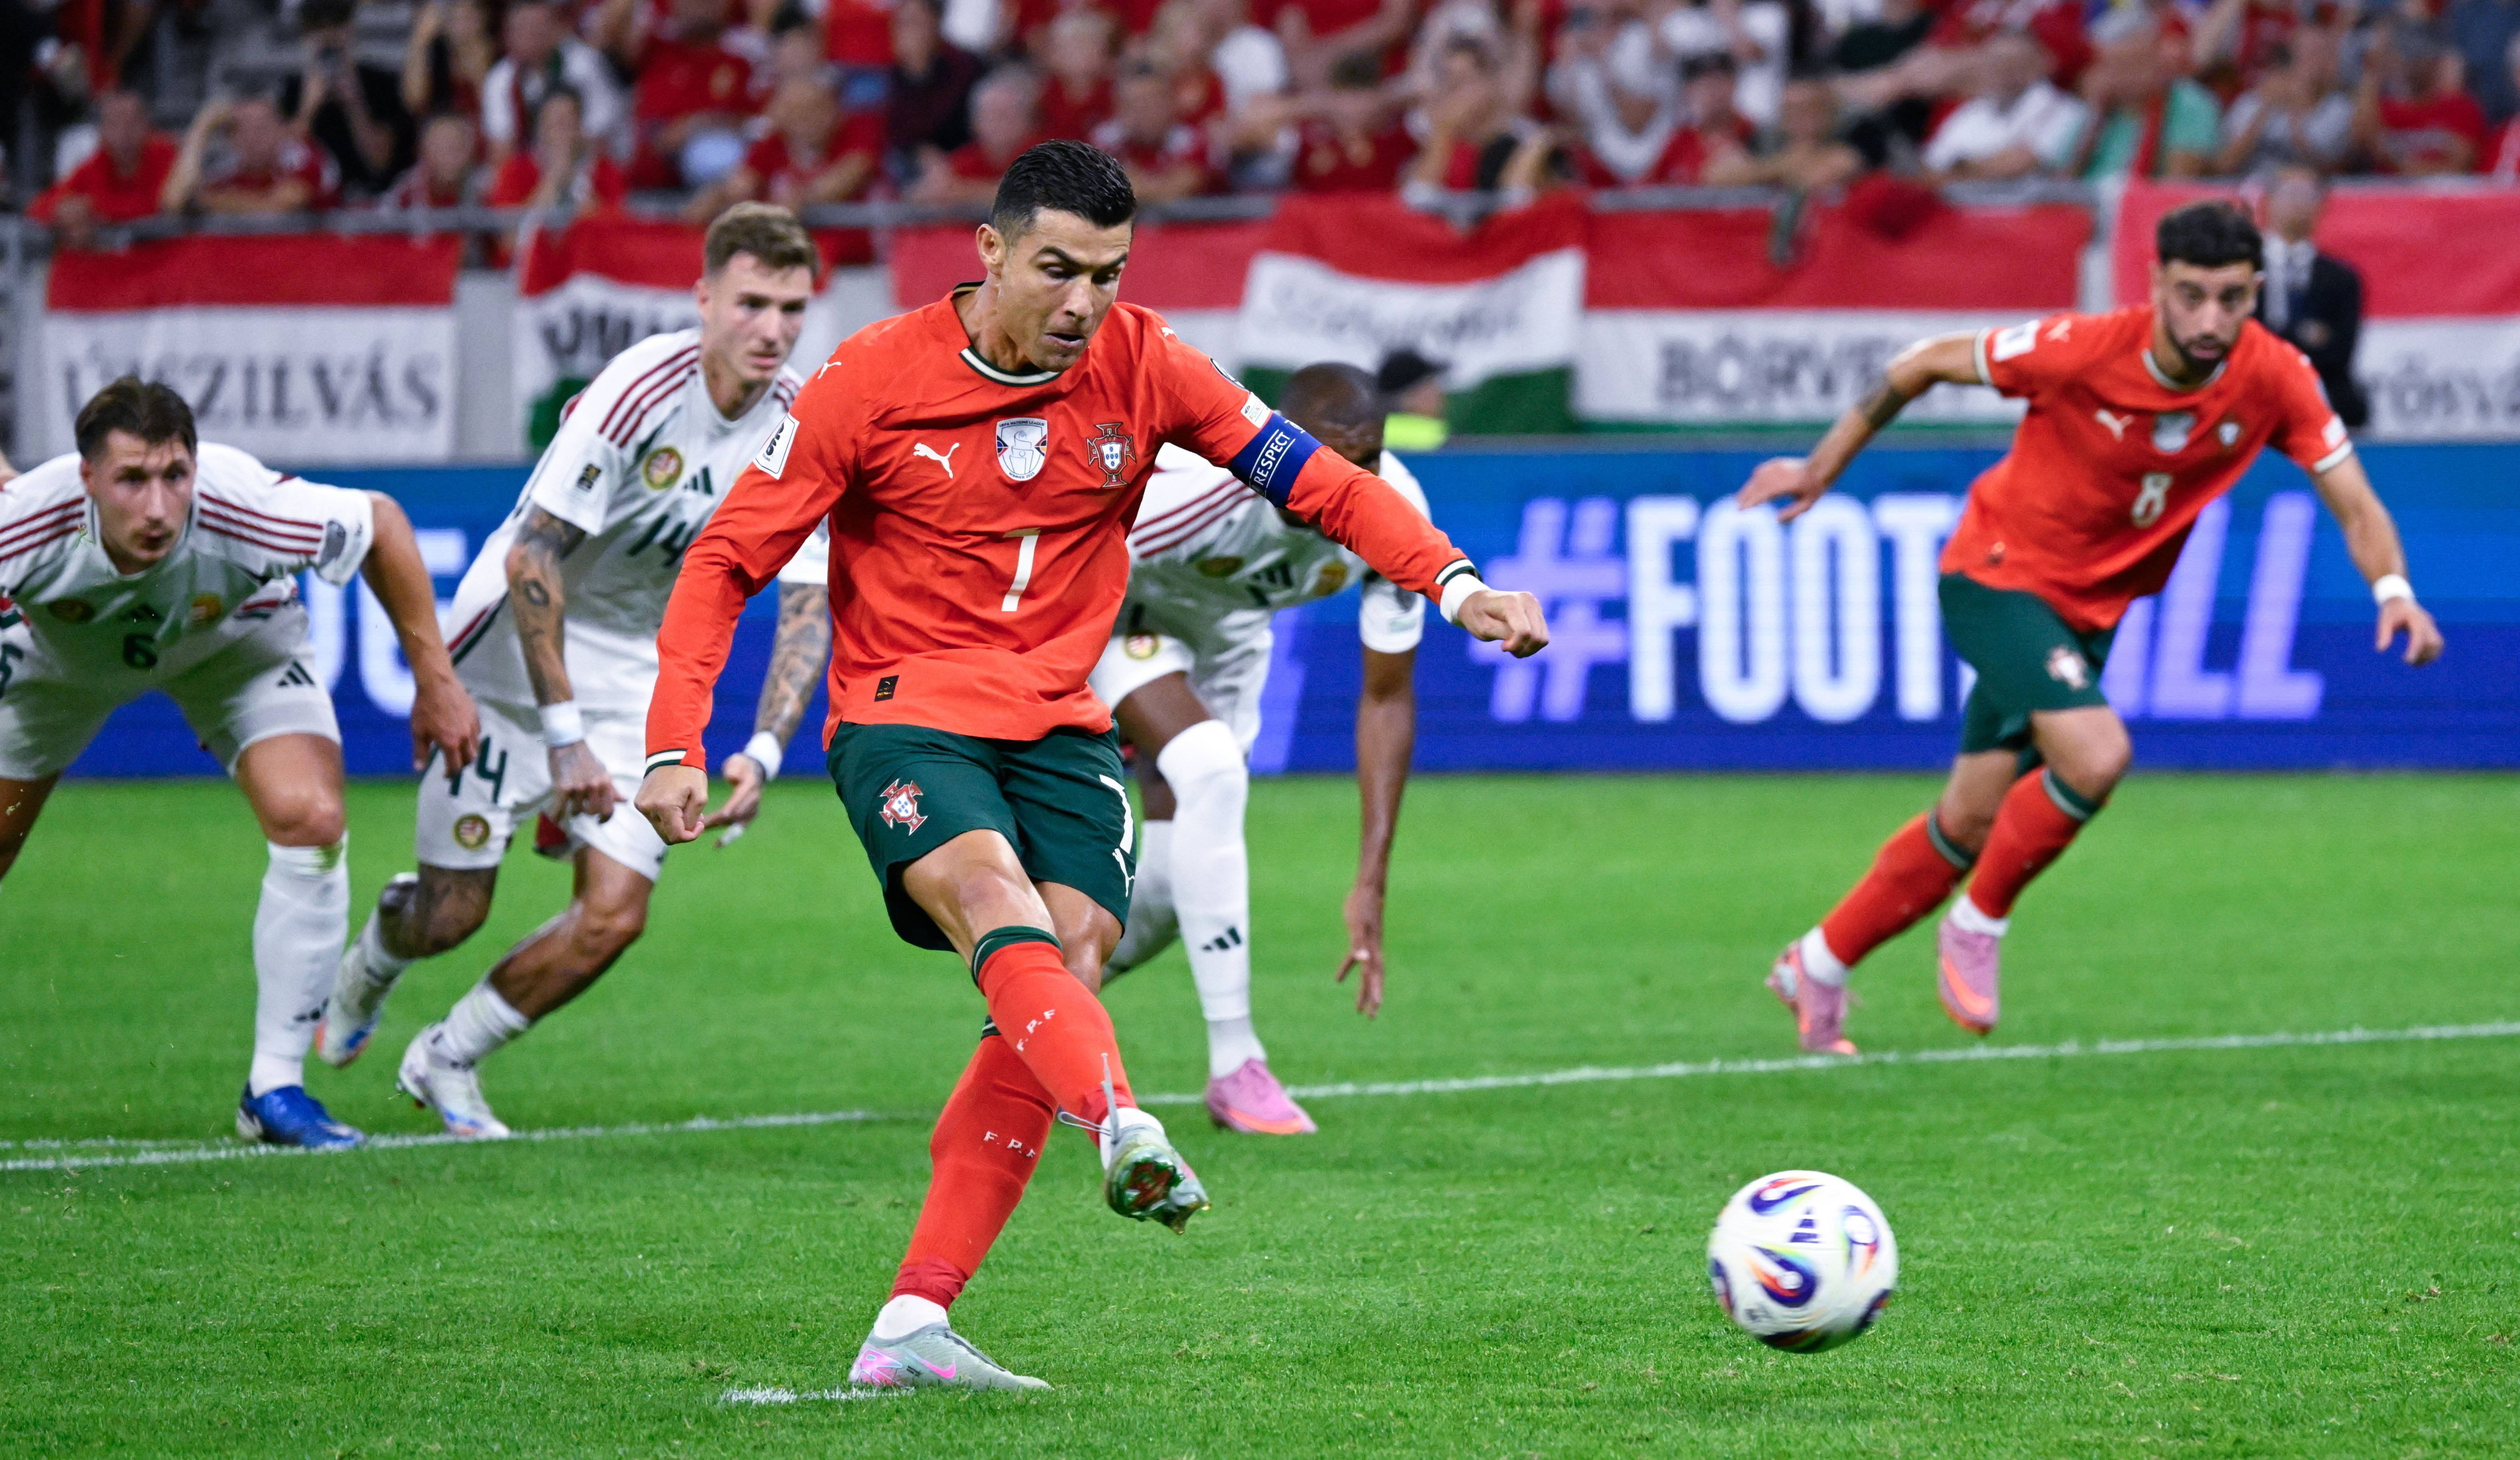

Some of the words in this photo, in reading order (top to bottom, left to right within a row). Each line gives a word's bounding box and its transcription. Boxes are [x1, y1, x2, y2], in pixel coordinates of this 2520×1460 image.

[1254, 432, 1290, 486] RESPECT
[2131, 472, 2173, 529] 8
[1002, 527, 1041, 612] 7
[1468, 491, 2324, 724] #FOOTLL
[122, 633, 159, 669] 6
[1099, 774, 1133, 854] 7
